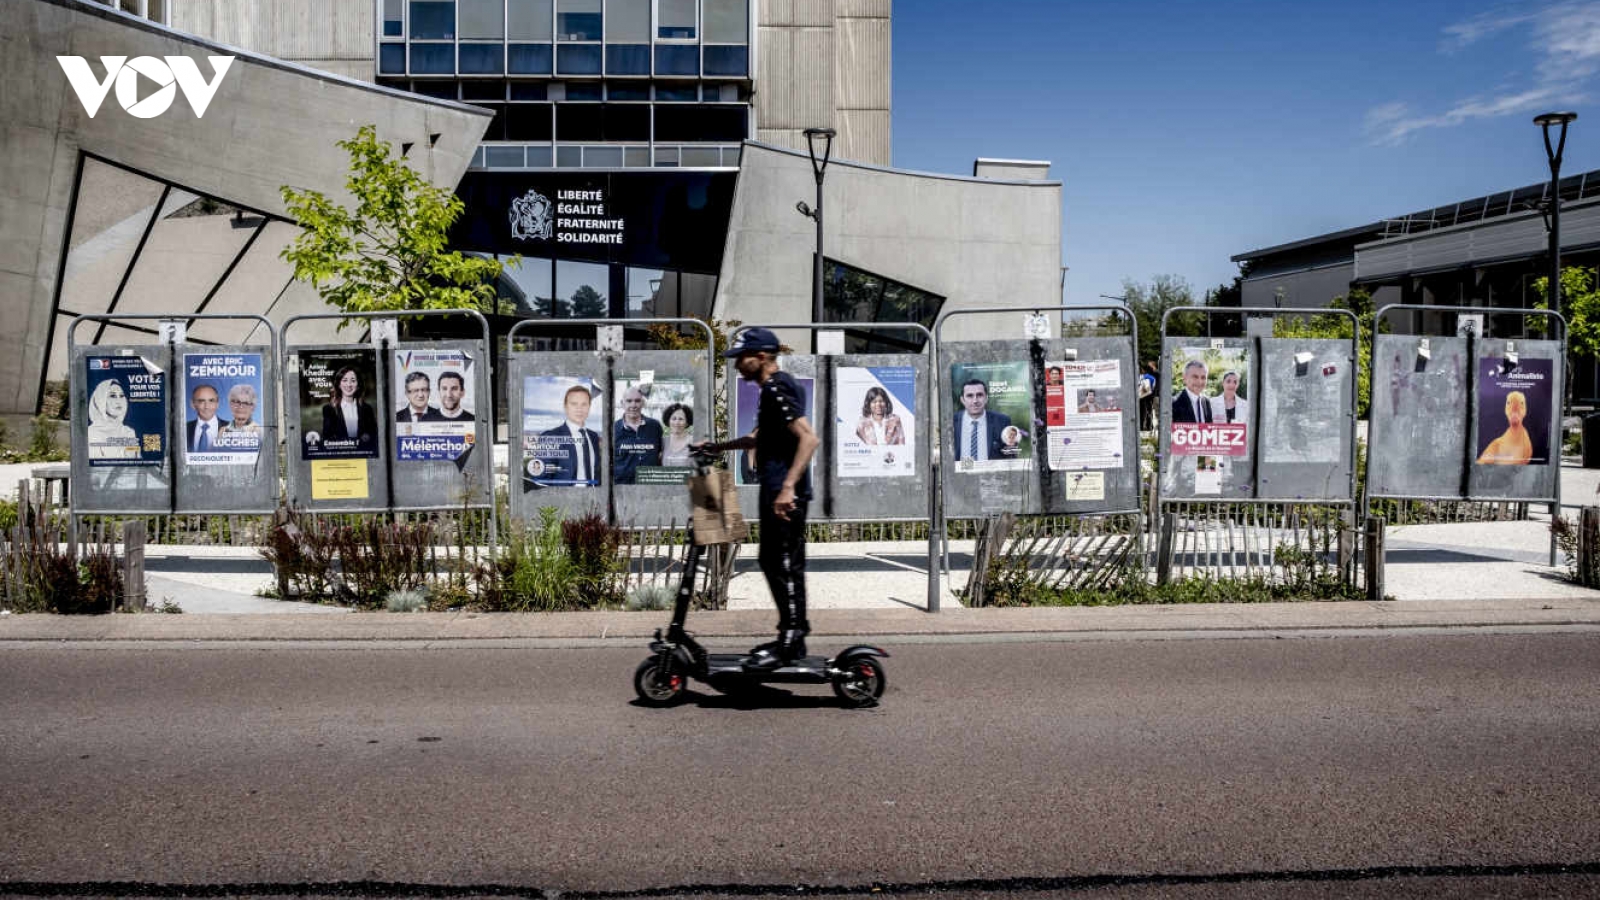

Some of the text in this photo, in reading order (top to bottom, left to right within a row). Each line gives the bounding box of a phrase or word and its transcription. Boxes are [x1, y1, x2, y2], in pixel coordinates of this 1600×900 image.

[557, 189, 603, 201] LIBERTÉ
[557, 202, 604, 215] ÉGALITÉ
[557, 218, 624, 229] FRATERNITÉ
[557, 232, 623, 244] SOLIDARITÉ
[202, 357, 224, 365] AVEC
[190, 365, 257, 377] ZEMMOUR
[128, 374, 162, 384] VOTEZ
[1172, 429, 1244, 446] GOMEZ
